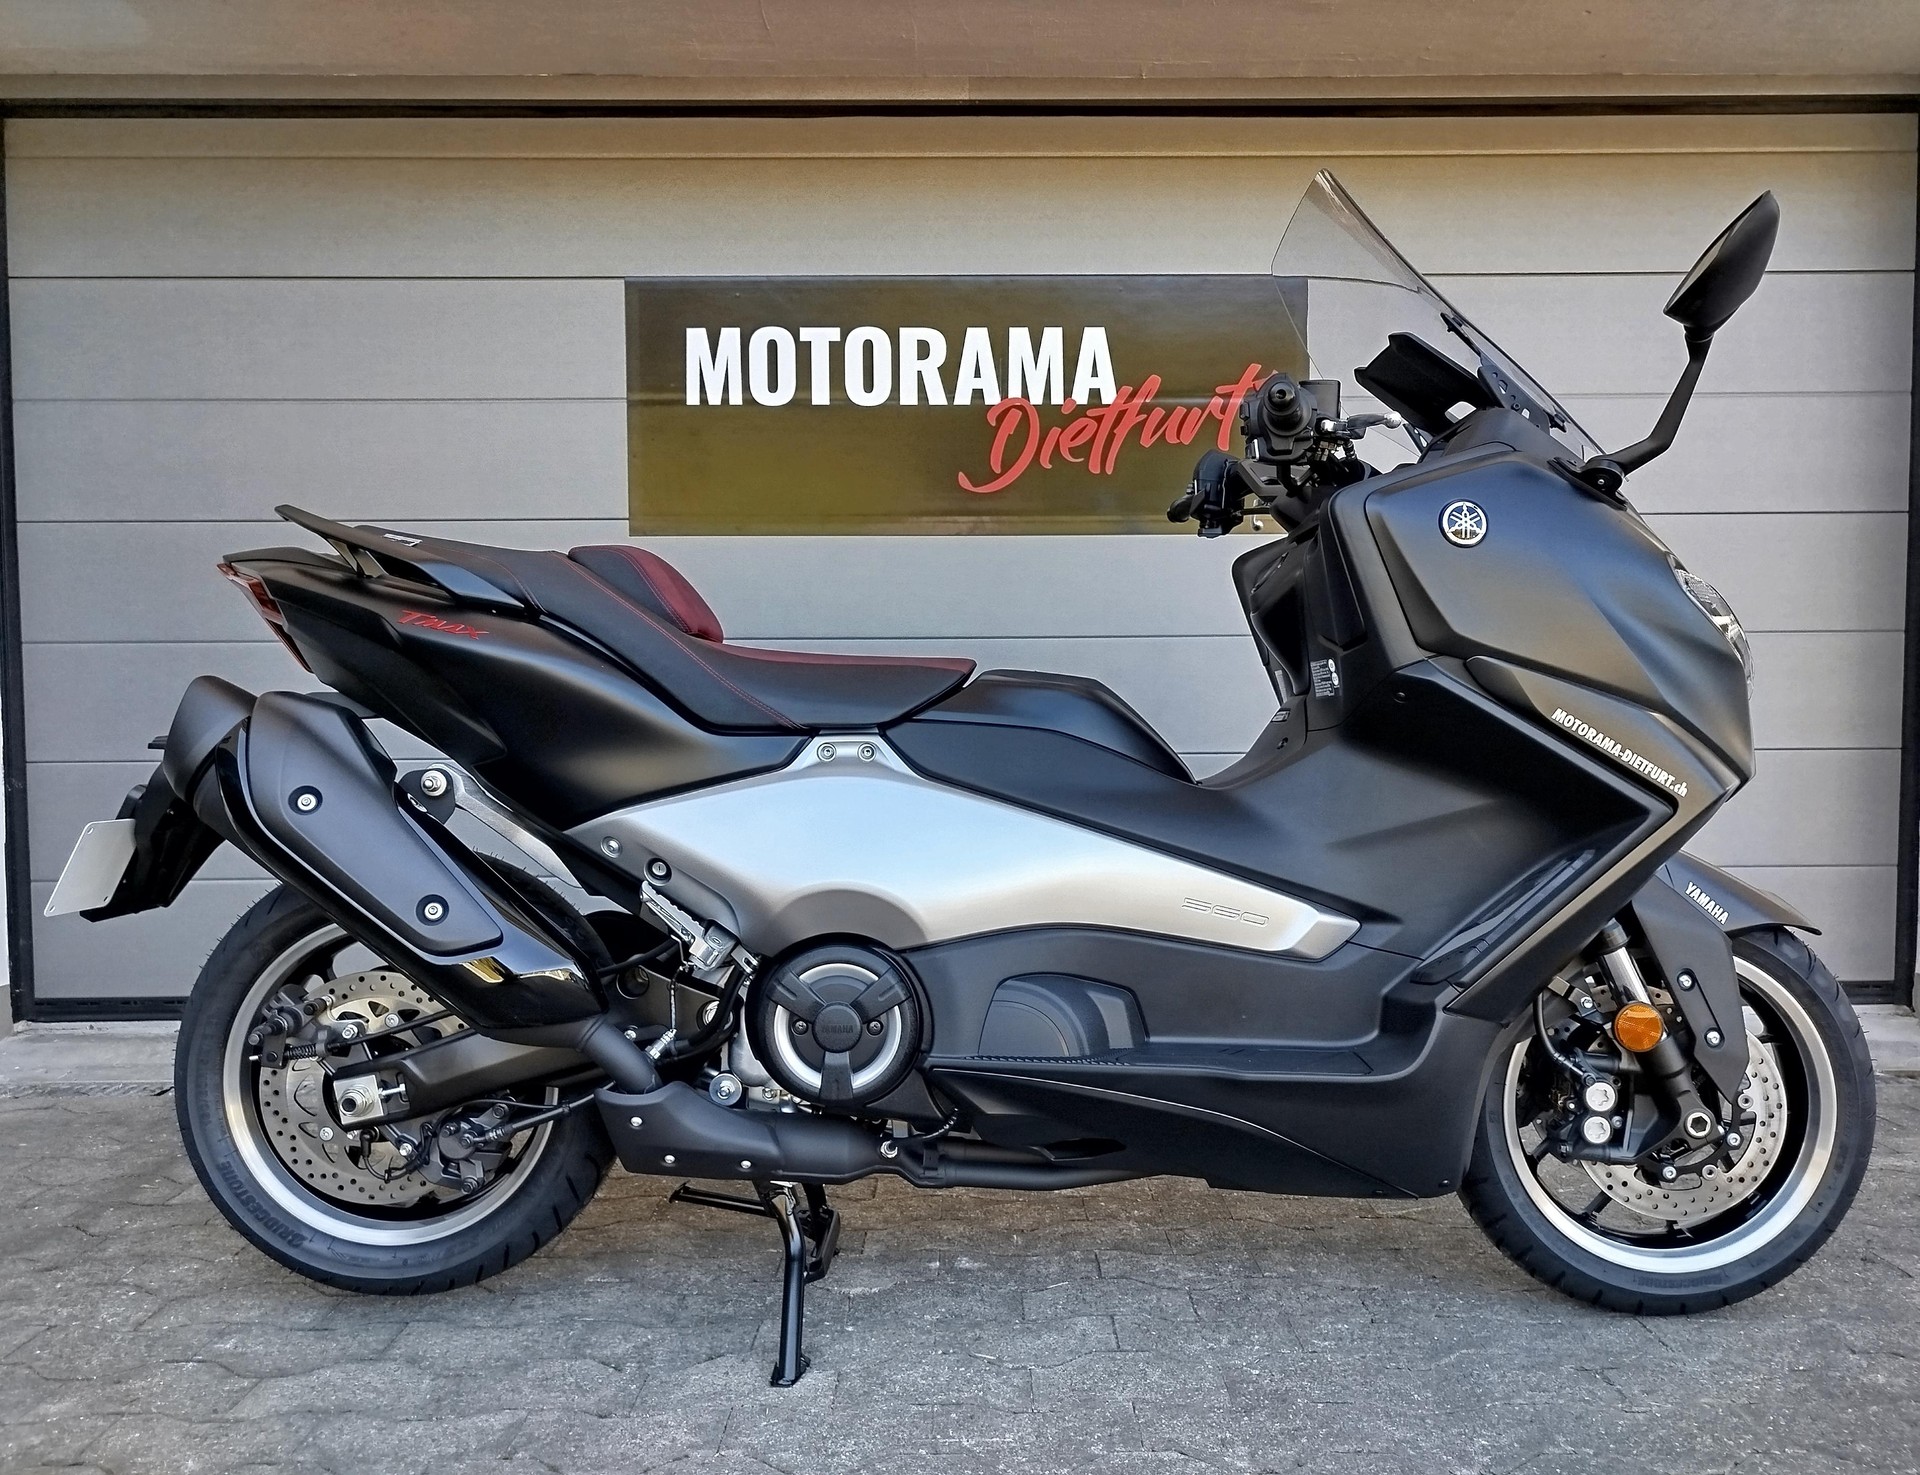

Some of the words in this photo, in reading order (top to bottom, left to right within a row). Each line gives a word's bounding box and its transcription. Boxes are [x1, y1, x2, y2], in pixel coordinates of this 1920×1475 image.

[685, 325, 1117, 406] MOTORAMA
[957, 362, 1279, 493] Dietfurt
[1551, 707, 1688, 798] MOTORAMA-DIETFURT.ch
[1684, 881, 1730, 925] YAMAHA
[821, 1023, 854, 1034] YAMAHA
[217, 1160, 309, 1249] BRIDGESTONE
